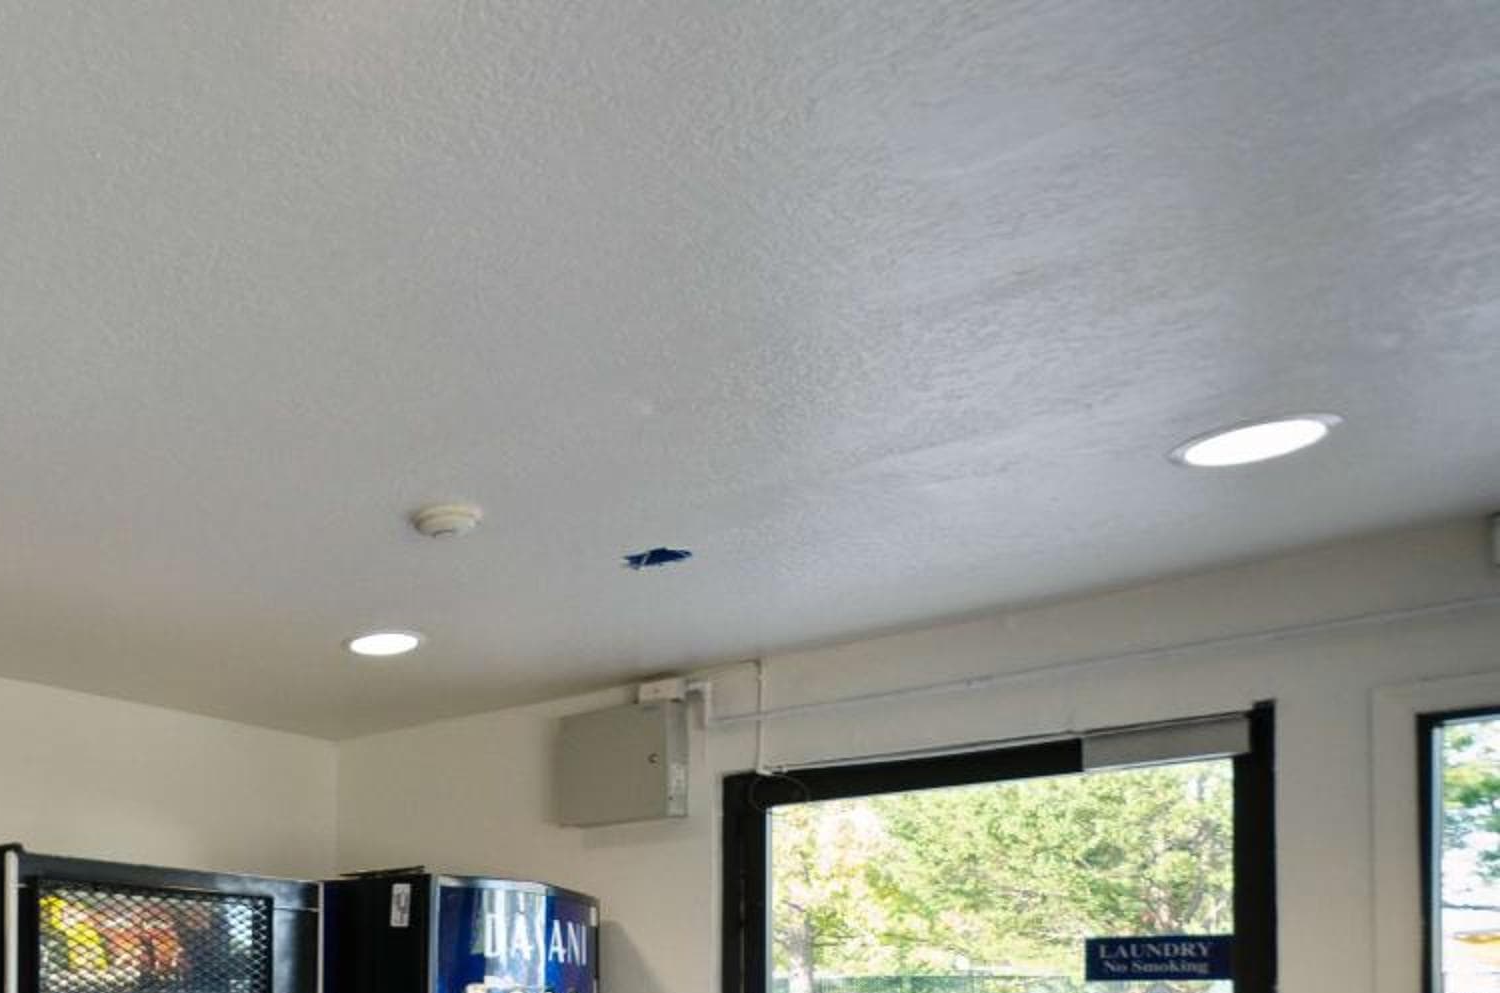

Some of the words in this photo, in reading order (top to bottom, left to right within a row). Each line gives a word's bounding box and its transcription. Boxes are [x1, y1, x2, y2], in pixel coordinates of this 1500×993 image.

[1099, 942, 1211, 960] LAUNDRY
[1102, 960, 1129, 973] No
[1131, 960, 1210, 975] Smoking
